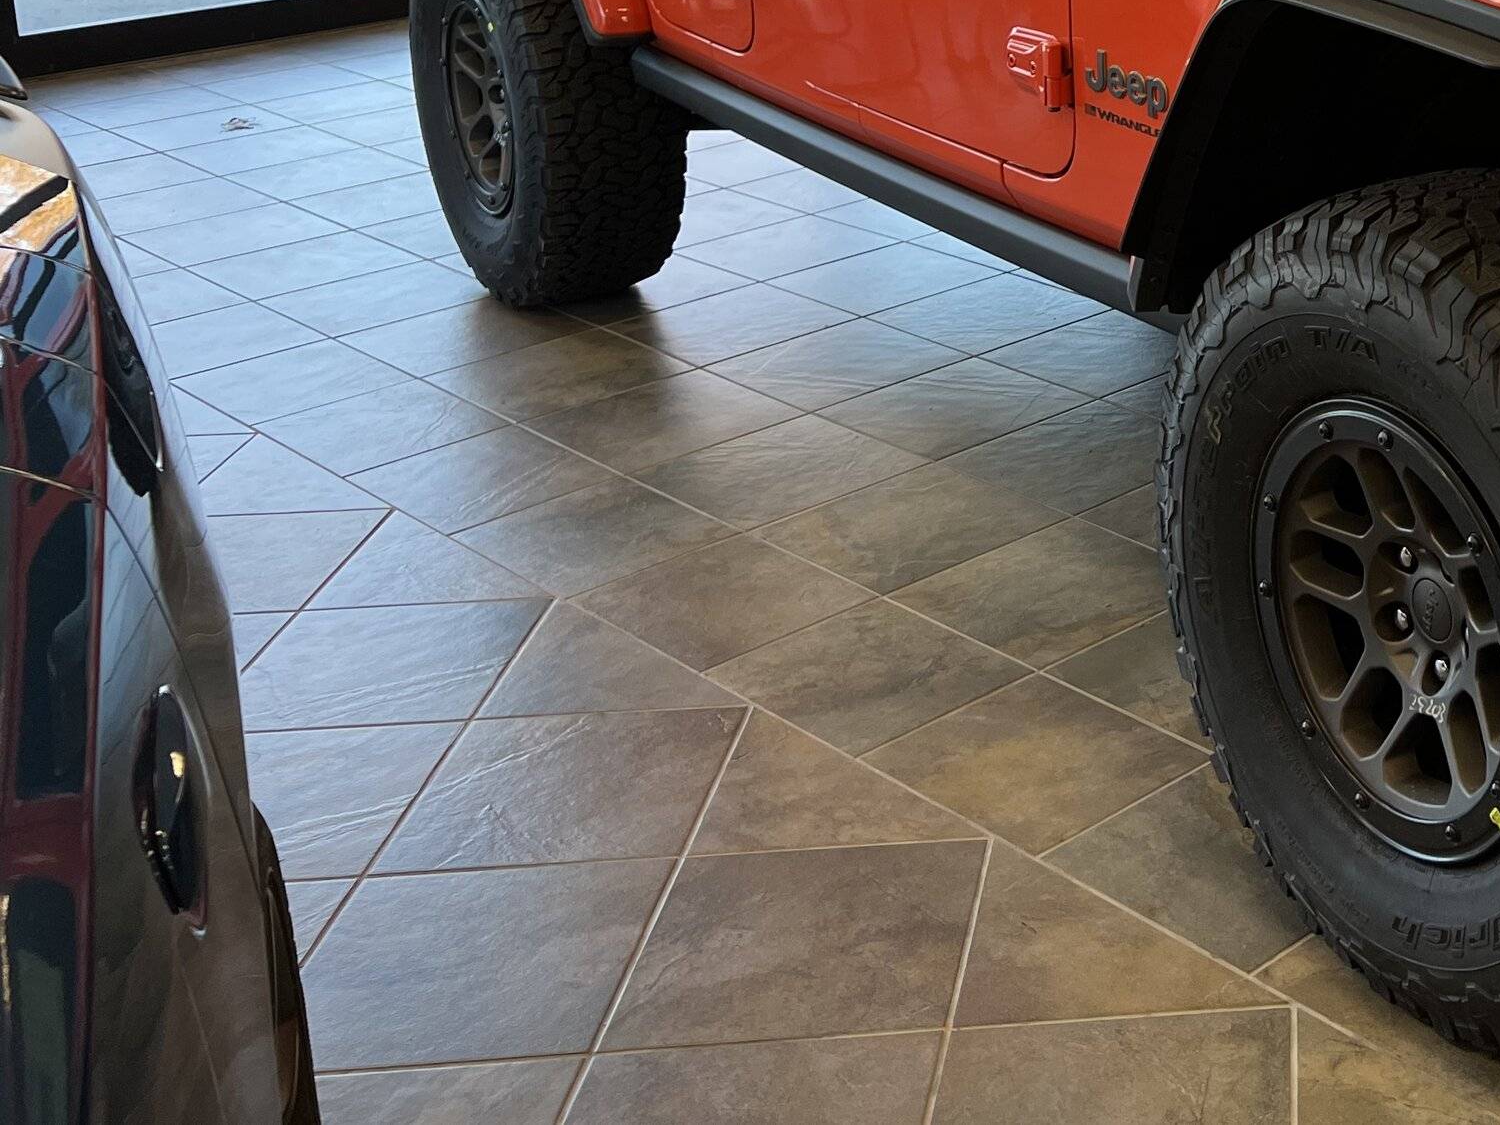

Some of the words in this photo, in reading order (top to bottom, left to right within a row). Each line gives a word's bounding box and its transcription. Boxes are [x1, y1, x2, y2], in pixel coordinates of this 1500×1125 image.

[1085, 48, 1169, 119] Jeep
[1096, 106, 1160, 137] WRANGLE
[1303, 325, 1380, 365] T/A
